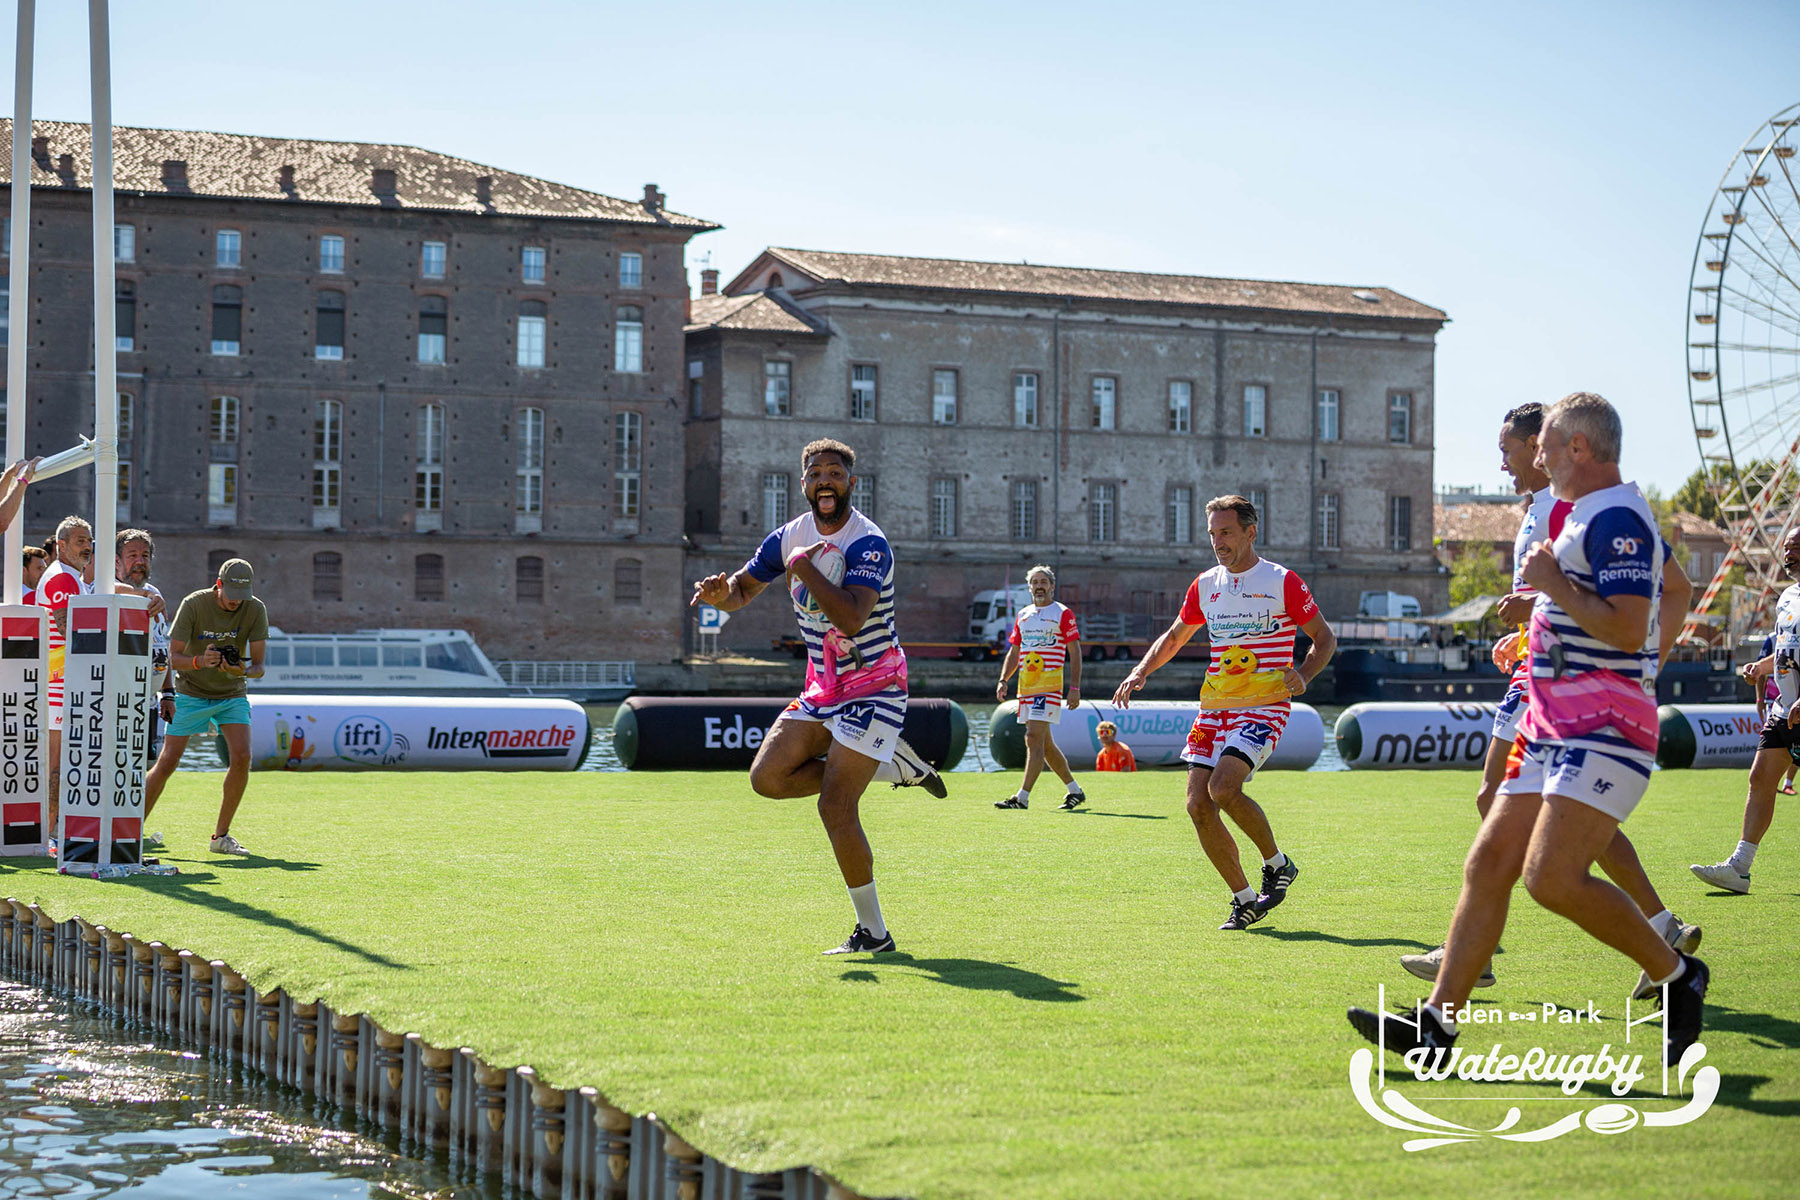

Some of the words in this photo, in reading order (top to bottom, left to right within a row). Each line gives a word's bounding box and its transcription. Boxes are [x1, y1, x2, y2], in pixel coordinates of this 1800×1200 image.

[862, 551, 880, 562] 90
[1612, 537, 1638, 555] 90
[702, 608, 719, 626] P
[3, 691, 18, 795] SOCIETE
[24, 667, 39, 794] GENERALE
[87, 664, 105, 807] GENERALE
[130, 666, 147, 807] GENERALE
[344, 723, 381, 746] ifri
[427, 724, 576, 758] Intermarché
[1372, 725, 1488, 764] métro
[1699, 719, 1733, 737] Das
[67, 691, 84, 805] SOCIETE
[113, 692, 129, 807] SOCIETE
[1703, 744, 1717, 755] Les
